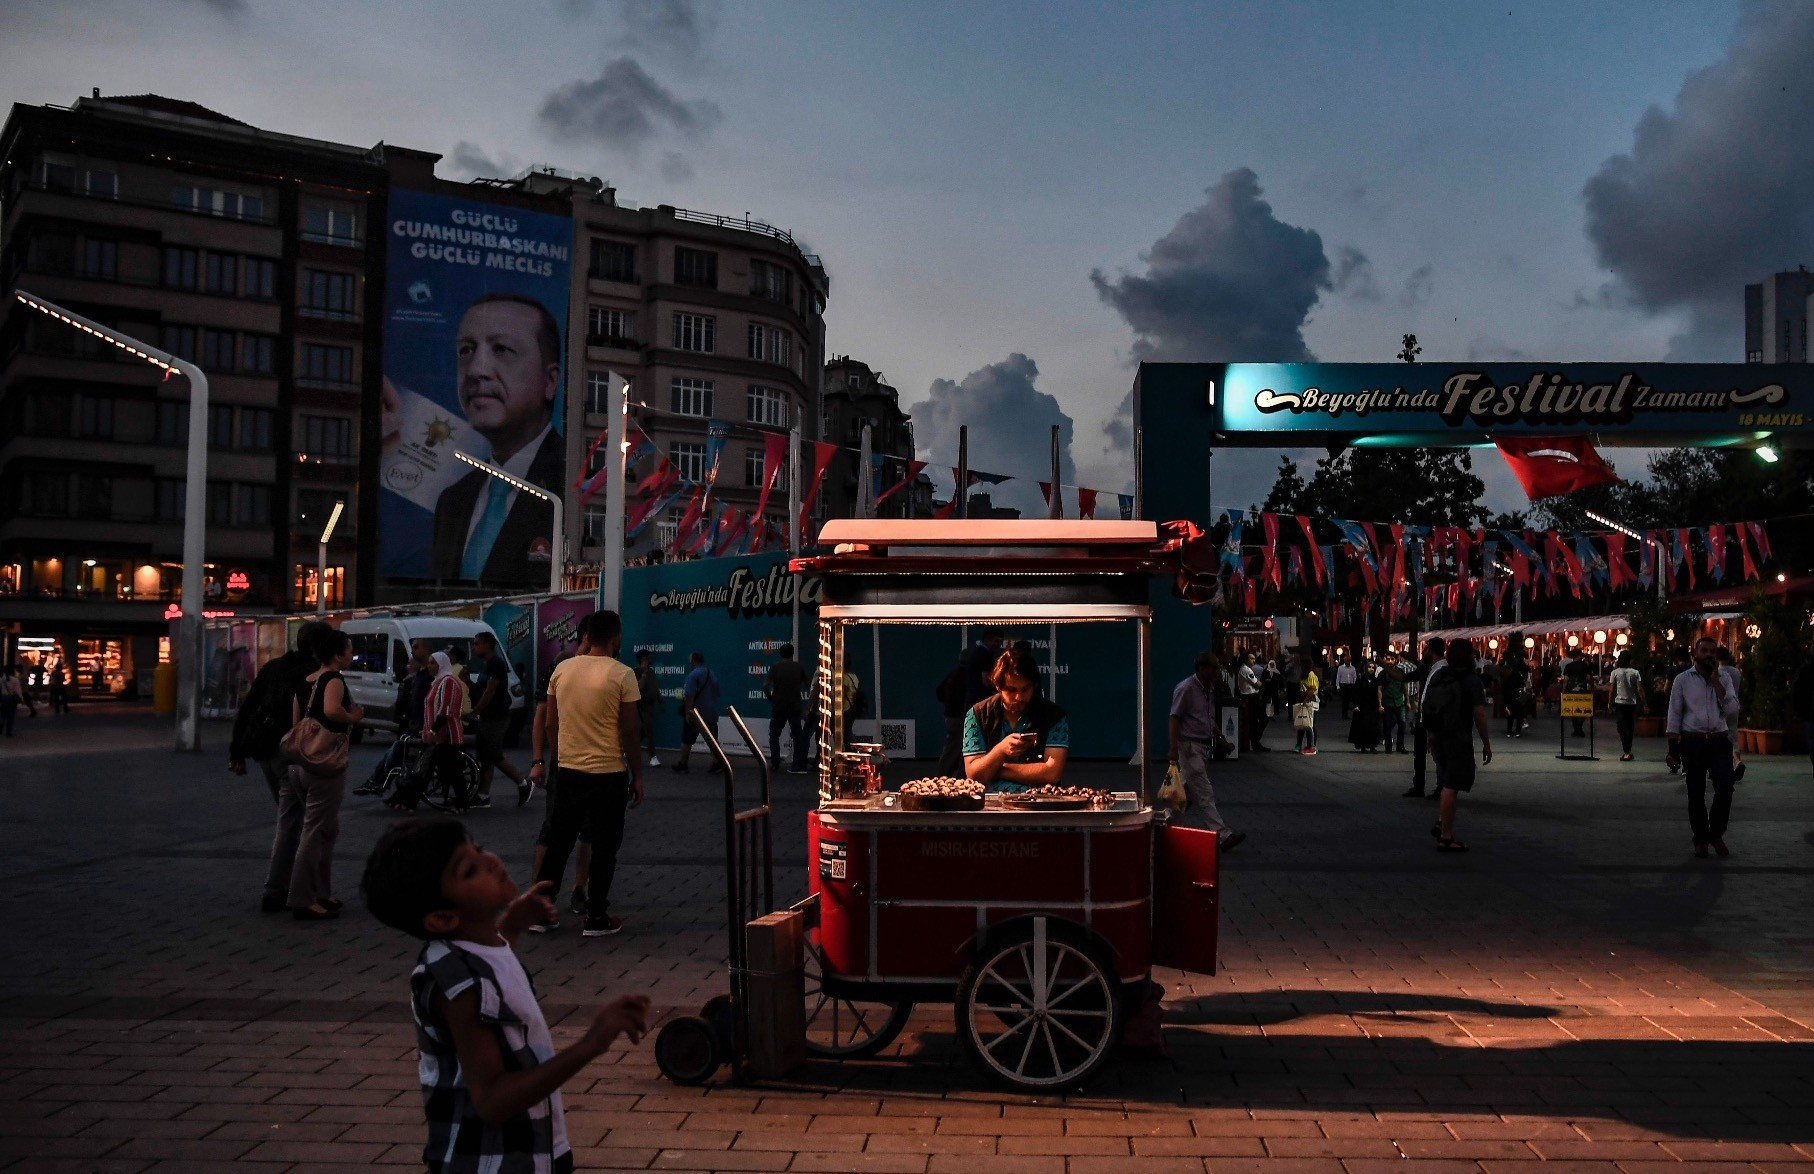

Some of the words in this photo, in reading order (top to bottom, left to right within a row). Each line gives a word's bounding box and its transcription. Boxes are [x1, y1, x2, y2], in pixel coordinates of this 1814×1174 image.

[451, 209, 518, 233] GÜÇLÜ
[392, 220, 568, 261] CUMHURBAŞKANI
[485, 251, 553, 277] MECLİS
[1302, 386, 1441, 414] Beyoğlu'nda
[1442, 372, 1627, 417] Festival
[1631, 385, 1728, 408] Zamanı
[1738, 413, 1754, 426] 18
[1756, 413, 1804, 426] MAYIS
[668, 585, 728, 610] Beyoğlu'nda
[728, 565, 823, 609] Festiva
[921, 840, 1040, 858] MISIR-KESTANE
